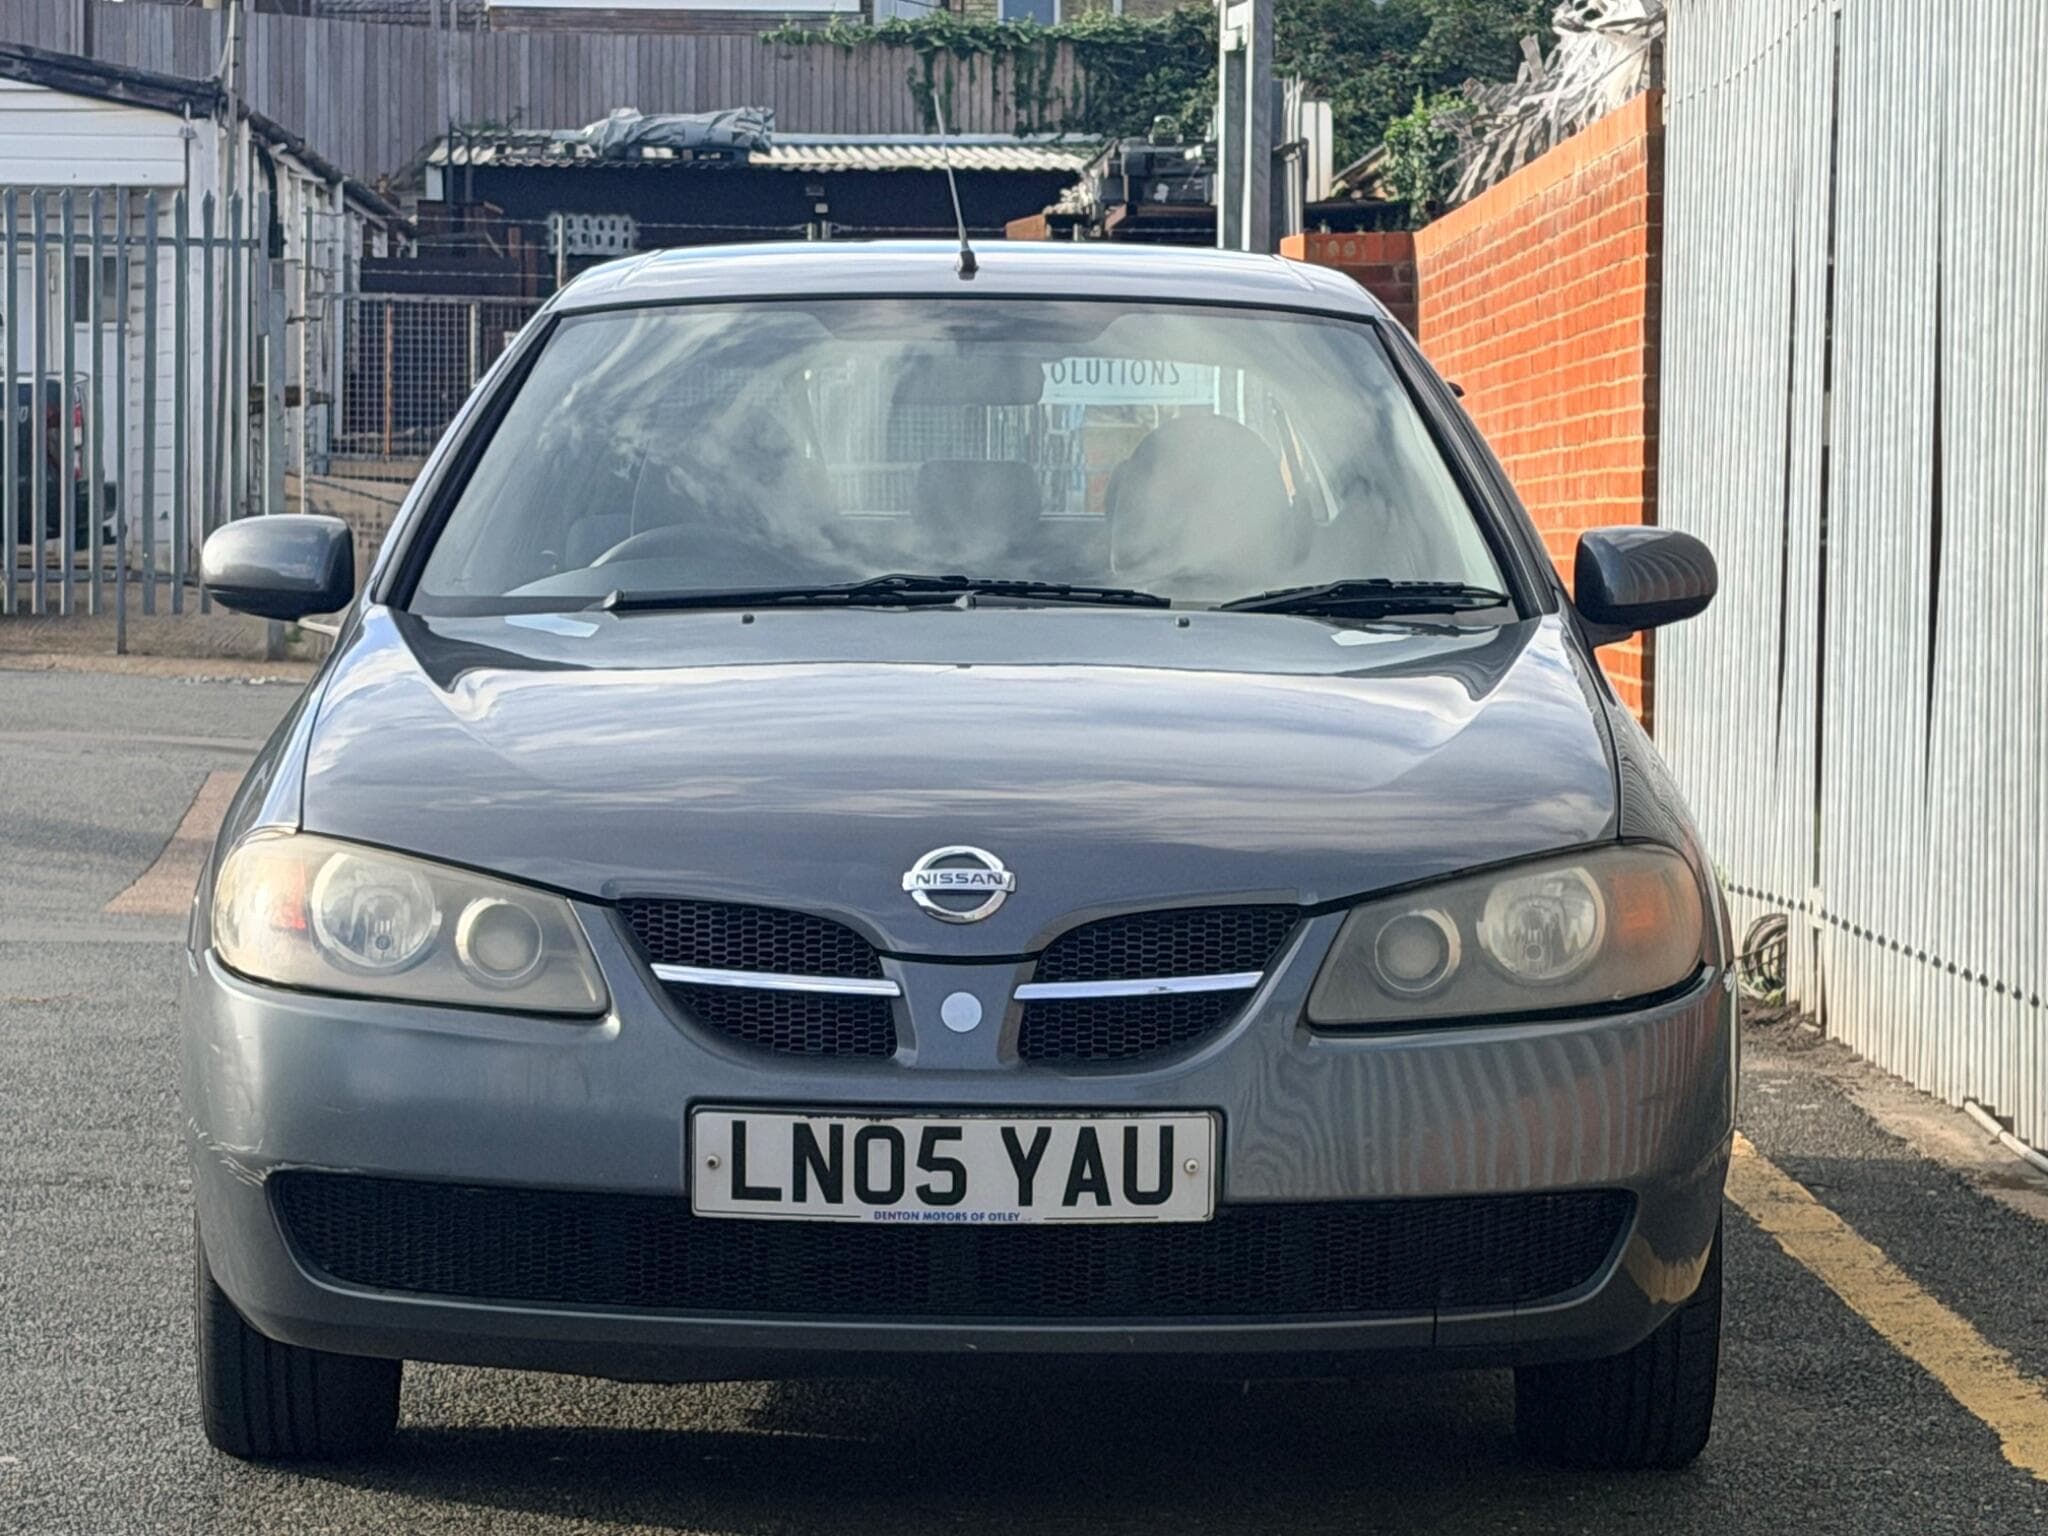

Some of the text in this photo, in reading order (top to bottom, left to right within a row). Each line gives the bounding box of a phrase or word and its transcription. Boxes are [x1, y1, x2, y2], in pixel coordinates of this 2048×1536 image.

[1050, 359, 1180, 386] OLUTIONS
[916, 873, 1003, 885] NISSAN
[731, 1120, 1174, 1207] LN05 YAU
[874, 1210, 1020, 1222] DENTON MOTORS OF OTLEY
